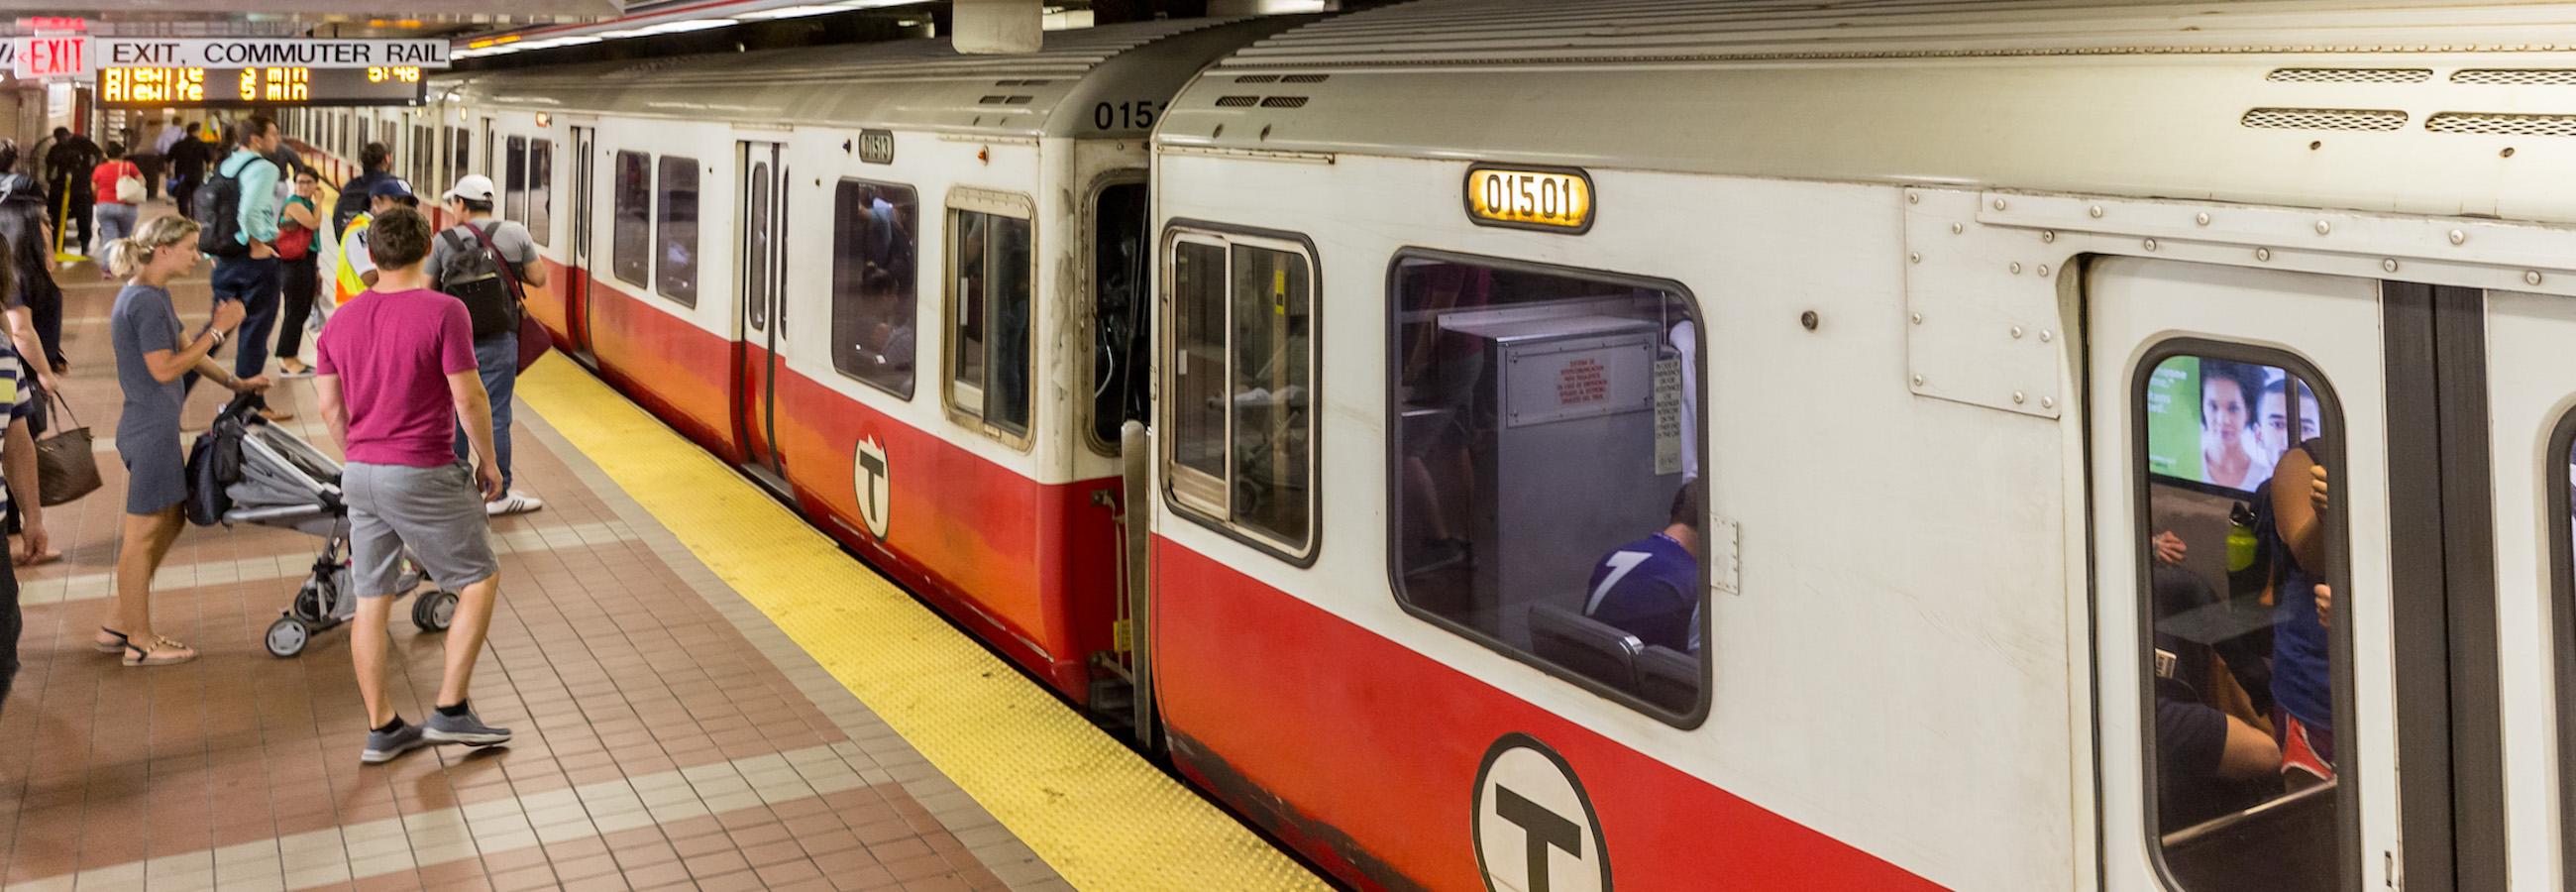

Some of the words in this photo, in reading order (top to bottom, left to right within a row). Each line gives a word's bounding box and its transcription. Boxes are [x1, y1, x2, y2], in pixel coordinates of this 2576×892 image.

[31, 40, 84, 73] EXIT
[113, 44, 186, 64] EXIT,
[204, 44, 370, 63] COMMUTER
[386, 44, 446, 62] RAIL
[266, 82, 308, 101] min
[1486, 174, 1570, 221] 01501
[859, 449, 884, 523] T
[1495, 782, 1582, 892] T
